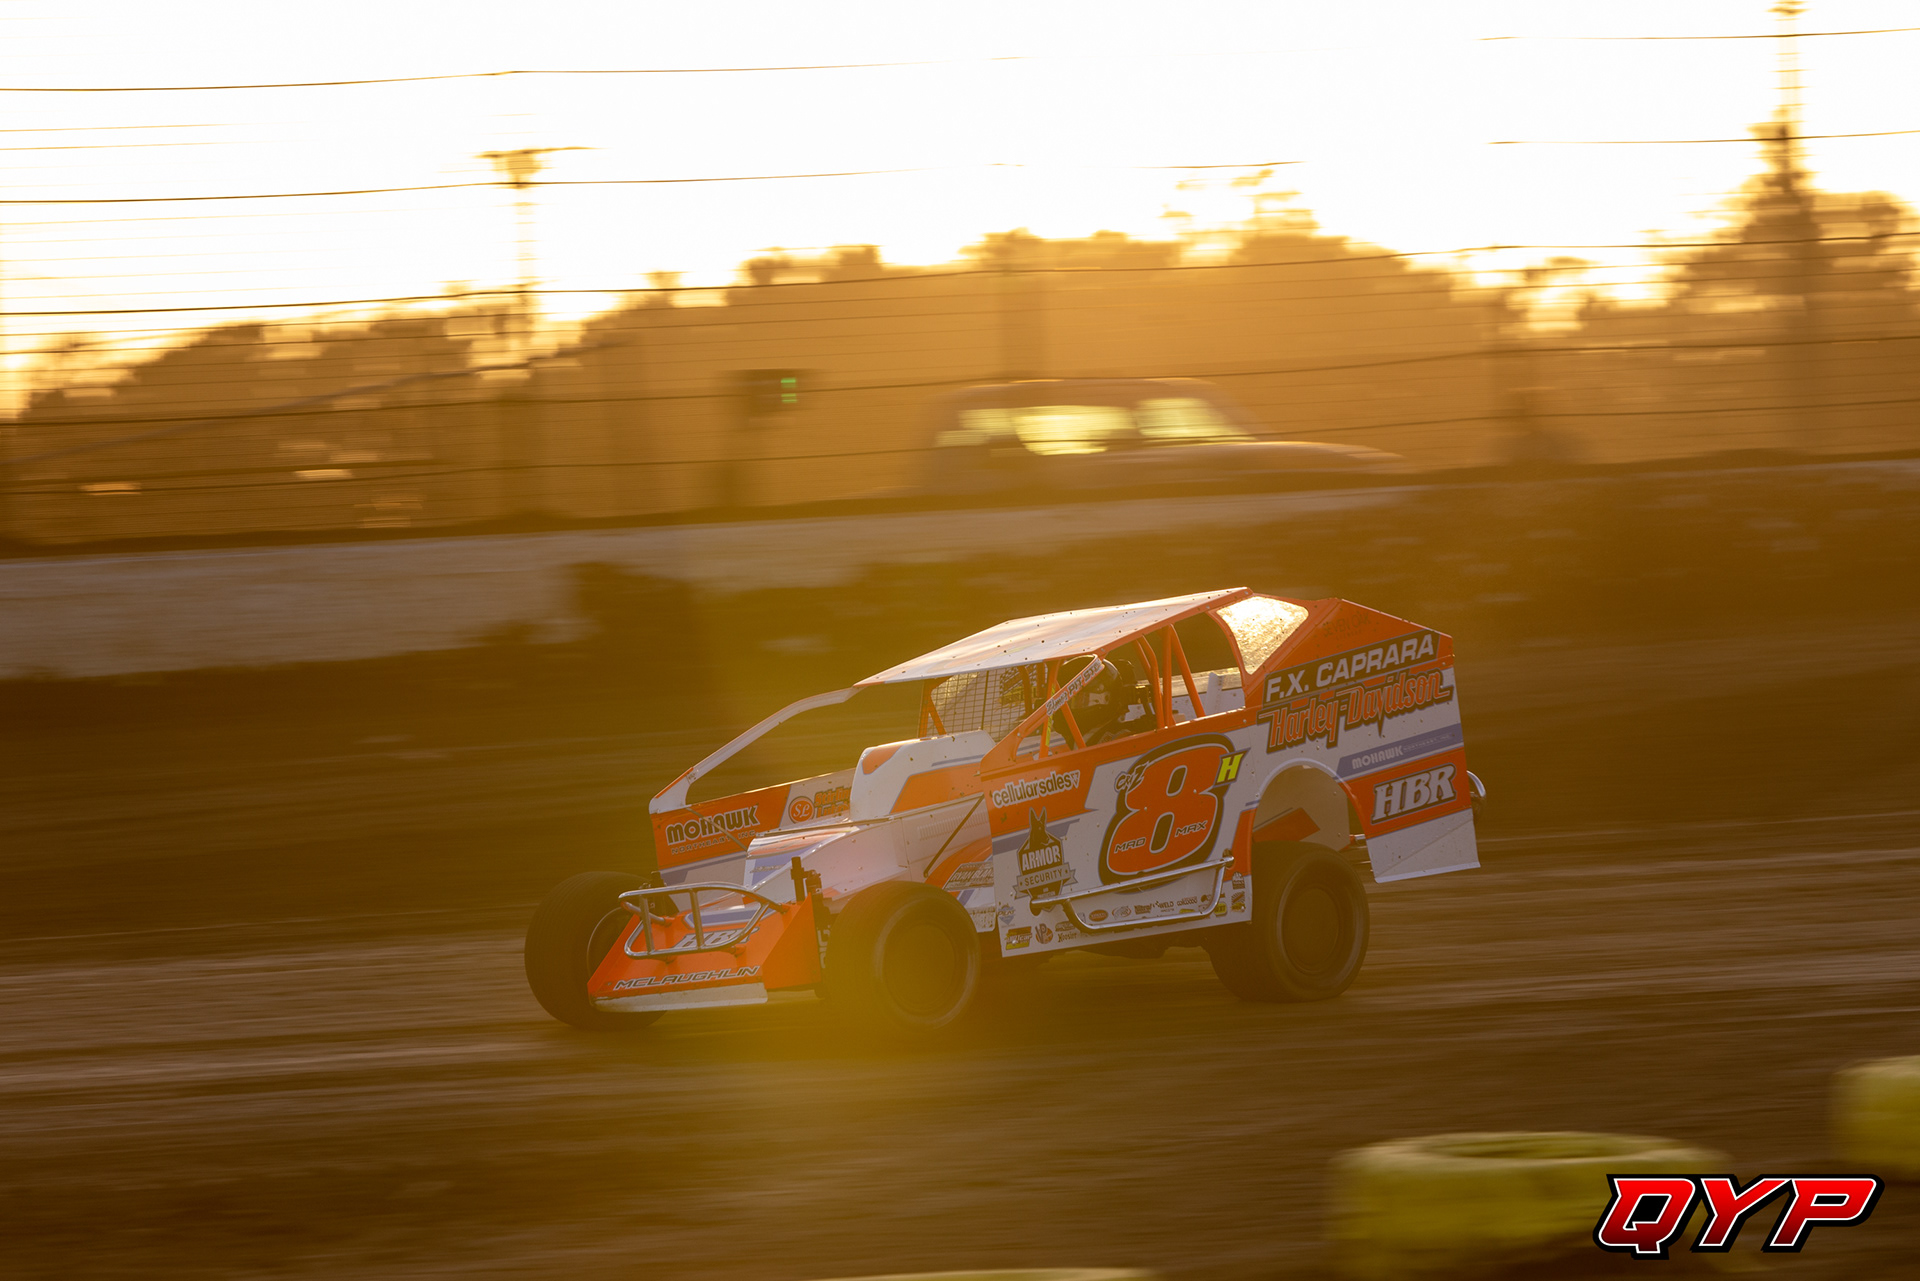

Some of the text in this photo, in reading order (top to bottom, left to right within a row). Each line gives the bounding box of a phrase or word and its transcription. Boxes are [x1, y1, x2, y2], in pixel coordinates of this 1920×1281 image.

[1266, 634, 1434, 702] F.X. CAPRARA
[1257, 668, 1452, 750] Harley-Davidson
[1218, 752, 1244, 784] H
[1351, 745, 1404, 769] MOHAWK
[814, 786, 851, 807] Stirlin
[993, 771, 1072, 808] cellularsales
[1372, 764, 1455, 822] HBR
[665, 805, 760, 846] MOHAWK
[1105, 742, 1232, 880] 8
[671, 834, 730, 855] NORTHEAST
[1114, 820, 1208, 853] MAD MAX
[1021, 844, 1060, 871] ARMOR
[1024, 868, 1064, 886] SECURITY
[613, 966, 760, 990] MCLAUGHLIN
